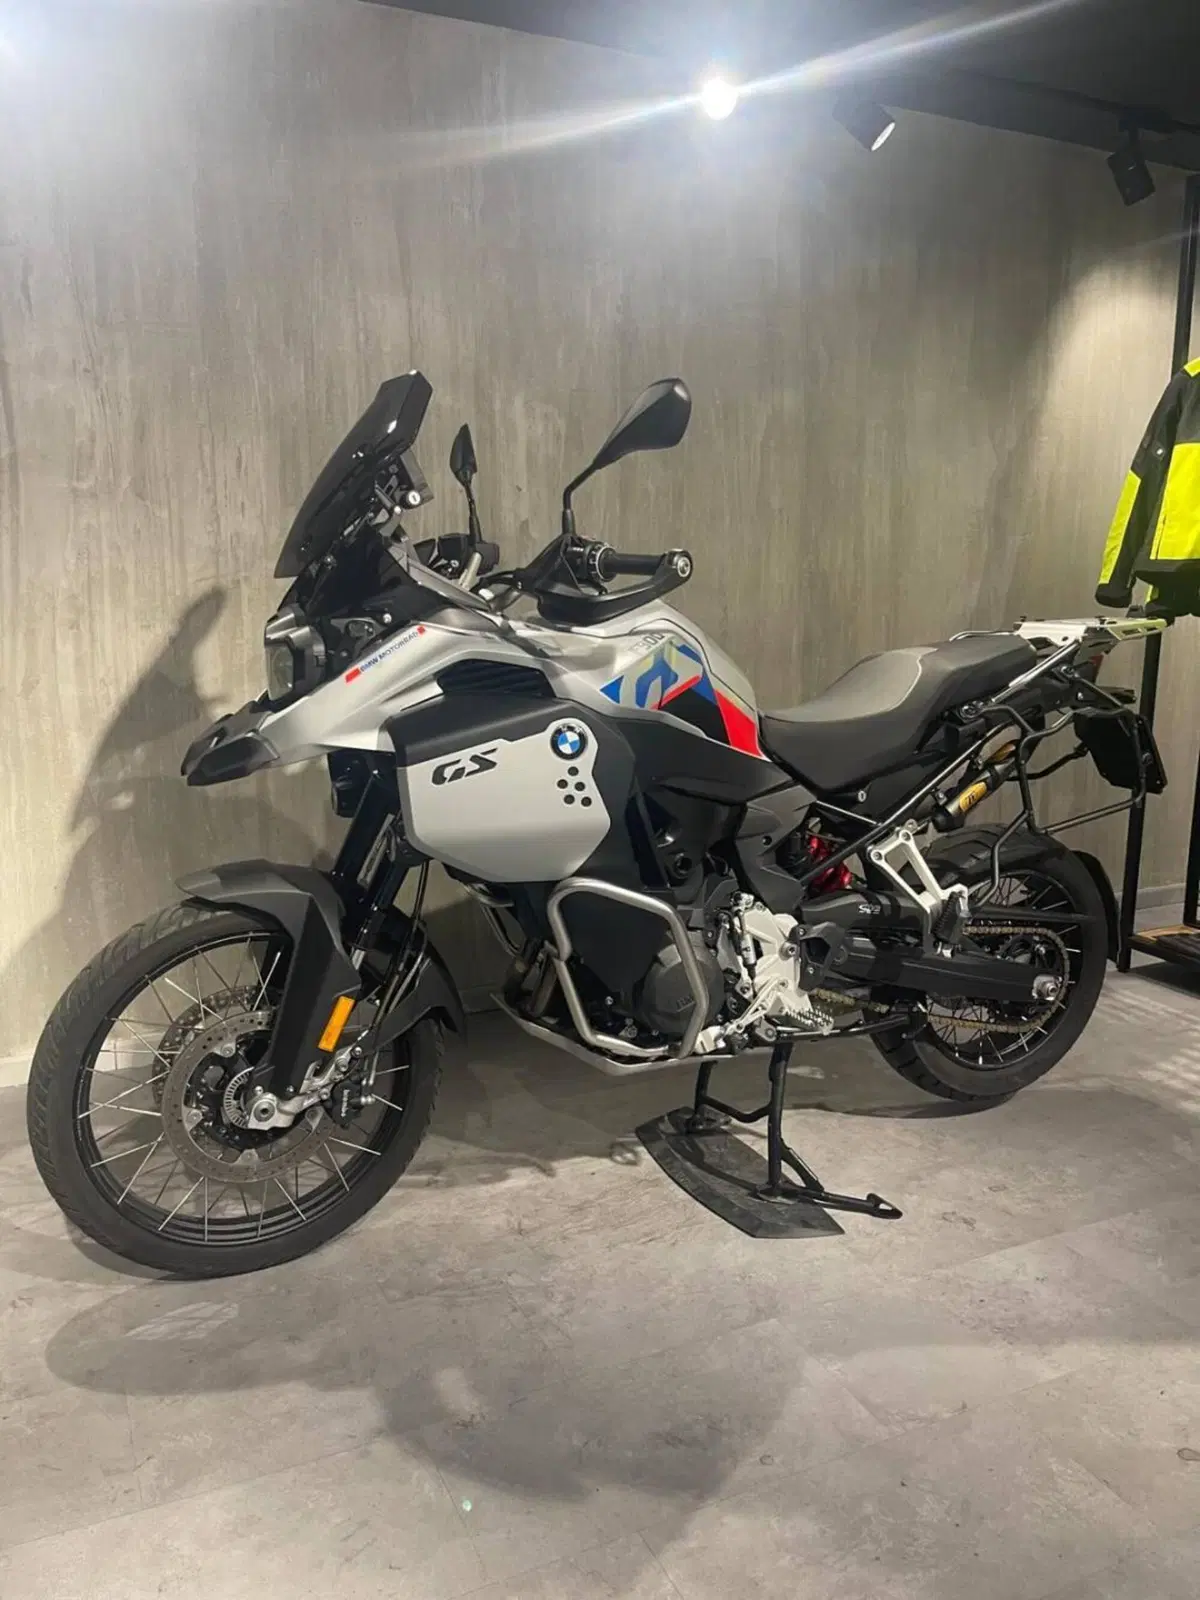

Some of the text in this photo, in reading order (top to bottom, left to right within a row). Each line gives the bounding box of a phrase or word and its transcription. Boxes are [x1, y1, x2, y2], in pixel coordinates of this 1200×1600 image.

[360, 631, 418, 672] BMW MOTORRAD
[432, 747, 498, 785] GS
